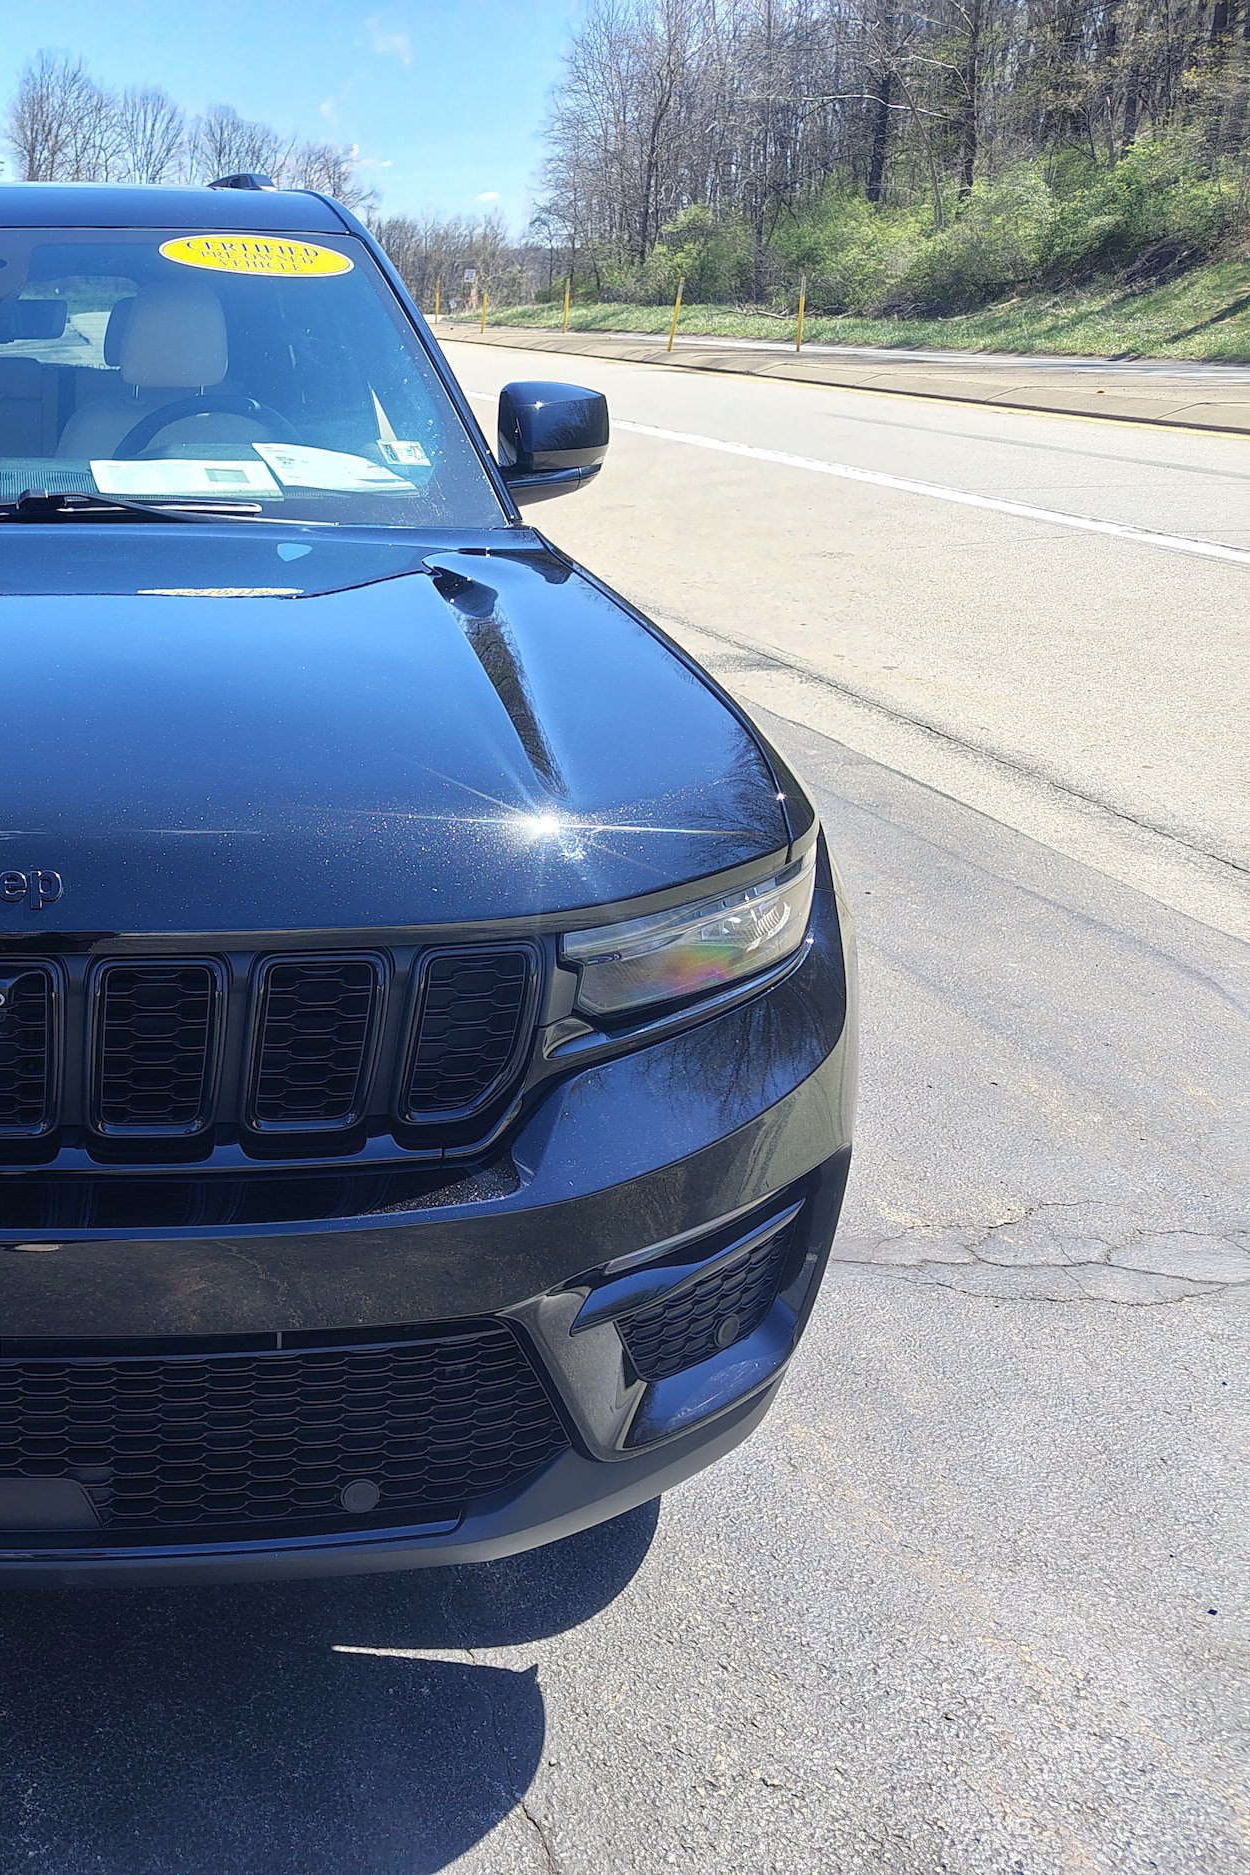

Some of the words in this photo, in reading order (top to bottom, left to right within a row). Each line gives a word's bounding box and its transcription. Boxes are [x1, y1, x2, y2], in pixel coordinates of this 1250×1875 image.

[185, 241, 319, 257] CERTIFIED
[200, 250, 315, 265] PRE-OWNED
[218, 258, 305, 272] VEHICLE
